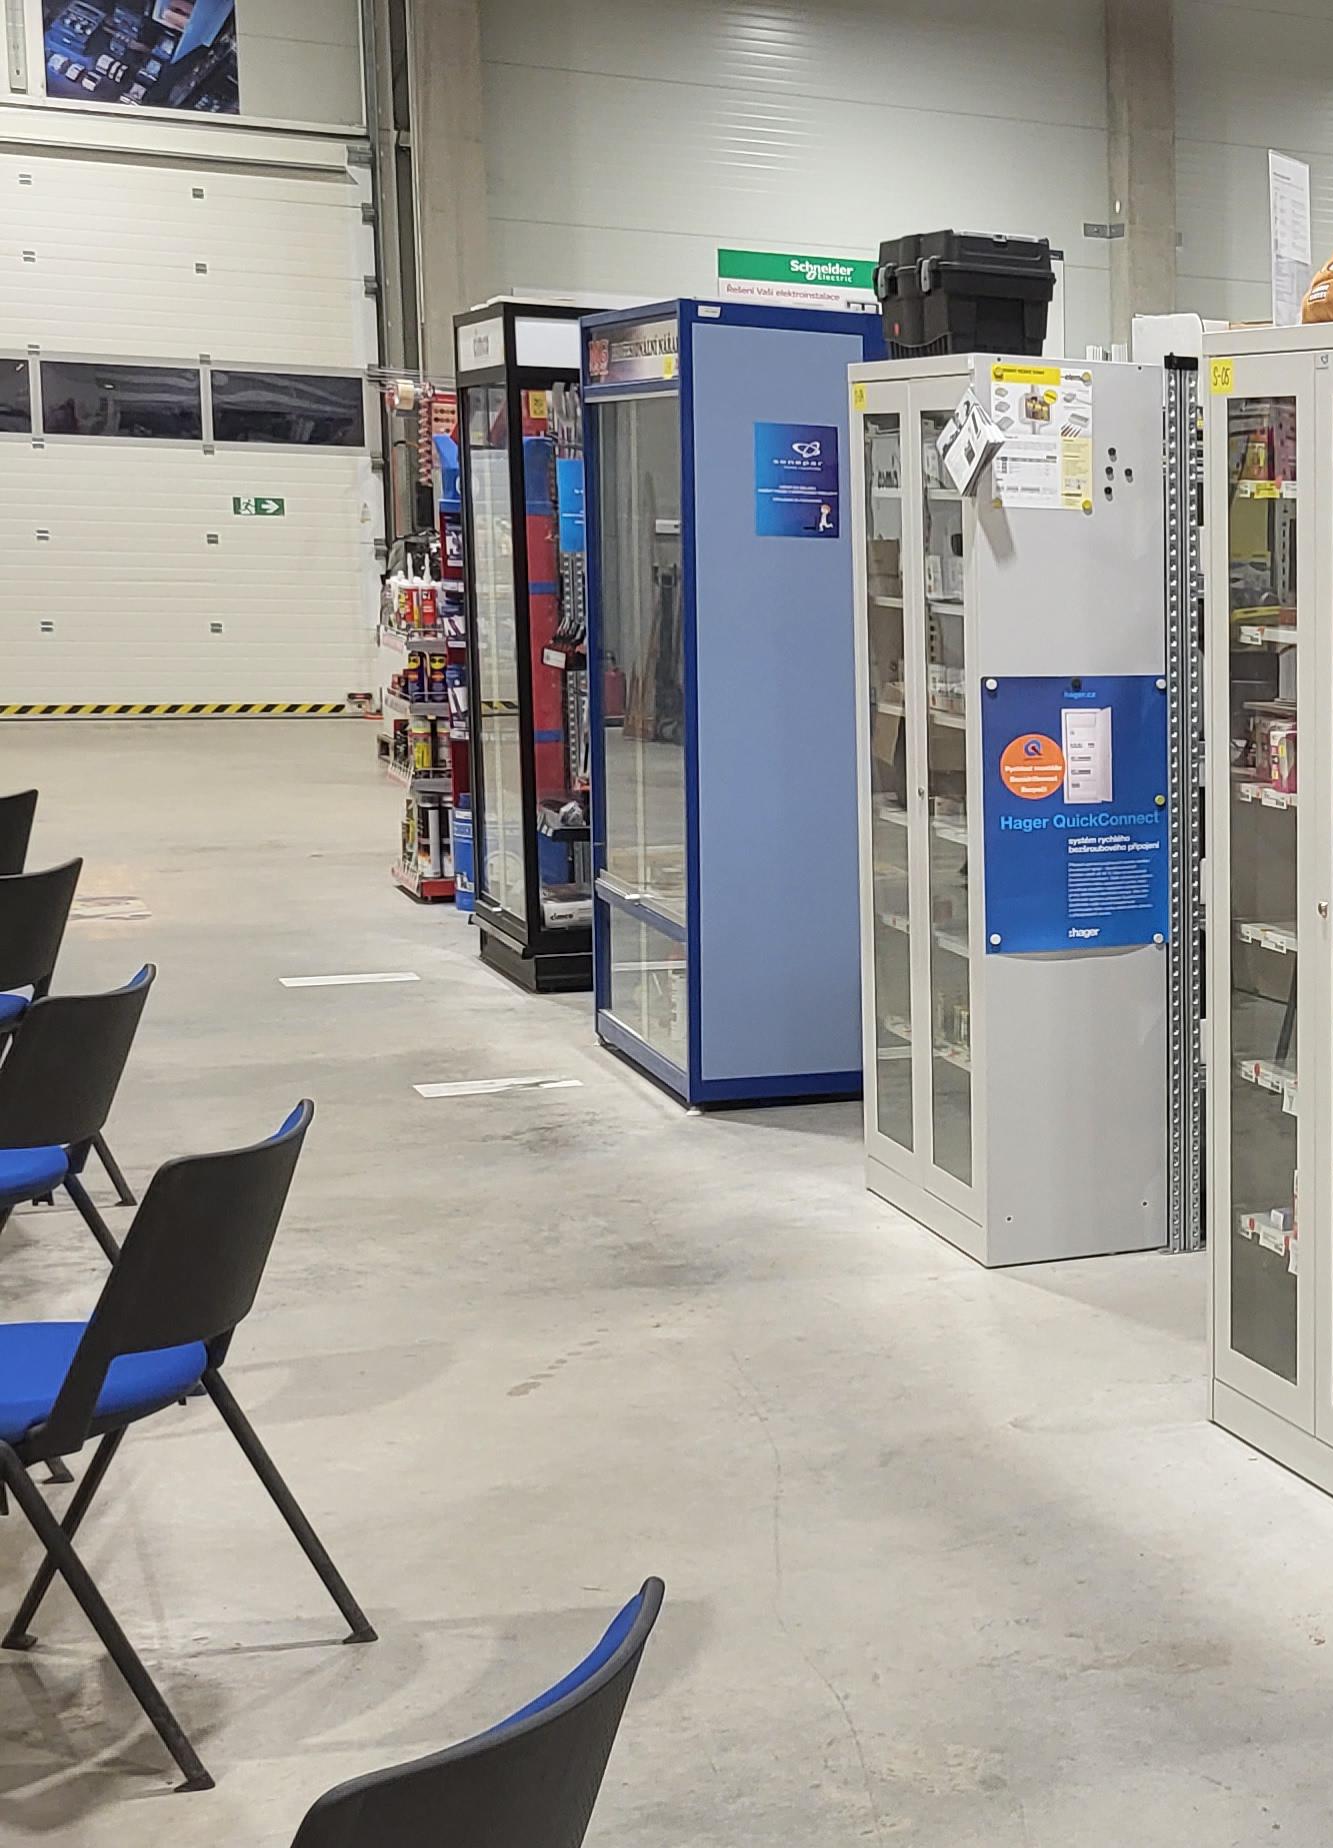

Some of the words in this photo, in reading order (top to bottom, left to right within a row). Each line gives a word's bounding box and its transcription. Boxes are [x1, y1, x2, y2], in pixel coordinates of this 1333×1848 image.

[790, 259, 854, 280] Schneider
[1000, 815, 1049, 833] Hager
[1053, 810, 1160, 829] QuickConnect
